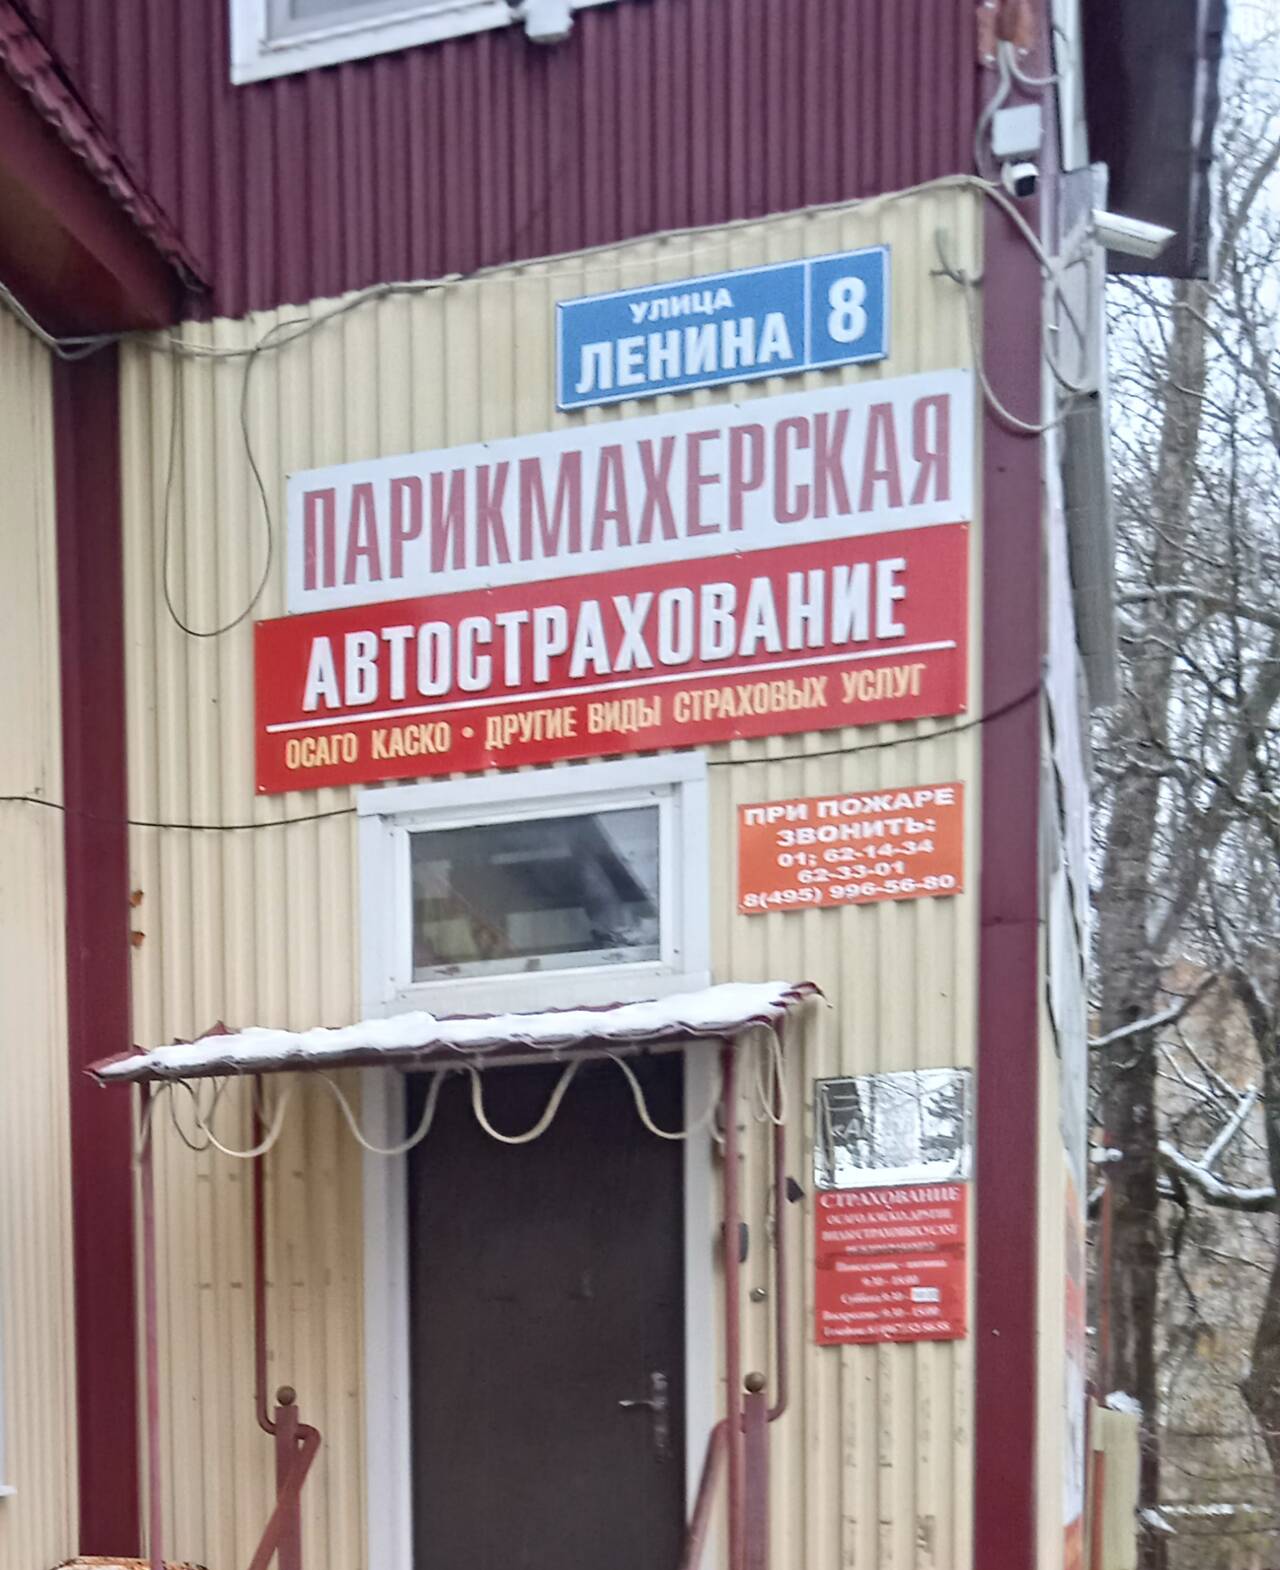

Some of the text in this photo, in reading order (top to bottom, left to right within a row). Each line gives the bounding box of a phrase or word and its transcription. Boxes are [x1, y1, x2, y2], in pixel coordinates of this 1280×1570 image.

[629, 287, 734, 323] УЛИЦА
[575, 276, 867, 394] ЛЕНИНА 8
[303, 393, 951, 591] ПАРИКМАХЕРСКАЯ
[303, 557, 907, 711] АВТОСТРАХОВАНИЕ
[286, 663, 926, 769] ОСАГО КАСКО ДРУГИЕ ВИДЫ СТРАХОВЫХ УСЛУГ
[744, 788, 955, 826] ПРИ ПОЖАРЕ
[776, 817, 936, 847] ЗВОНИТЬ:
[823, 838, 935, 863] 62-14-34
[797, 860, 905, 884] 62-33-01
[743, 886, 823, 908] 8(495)
